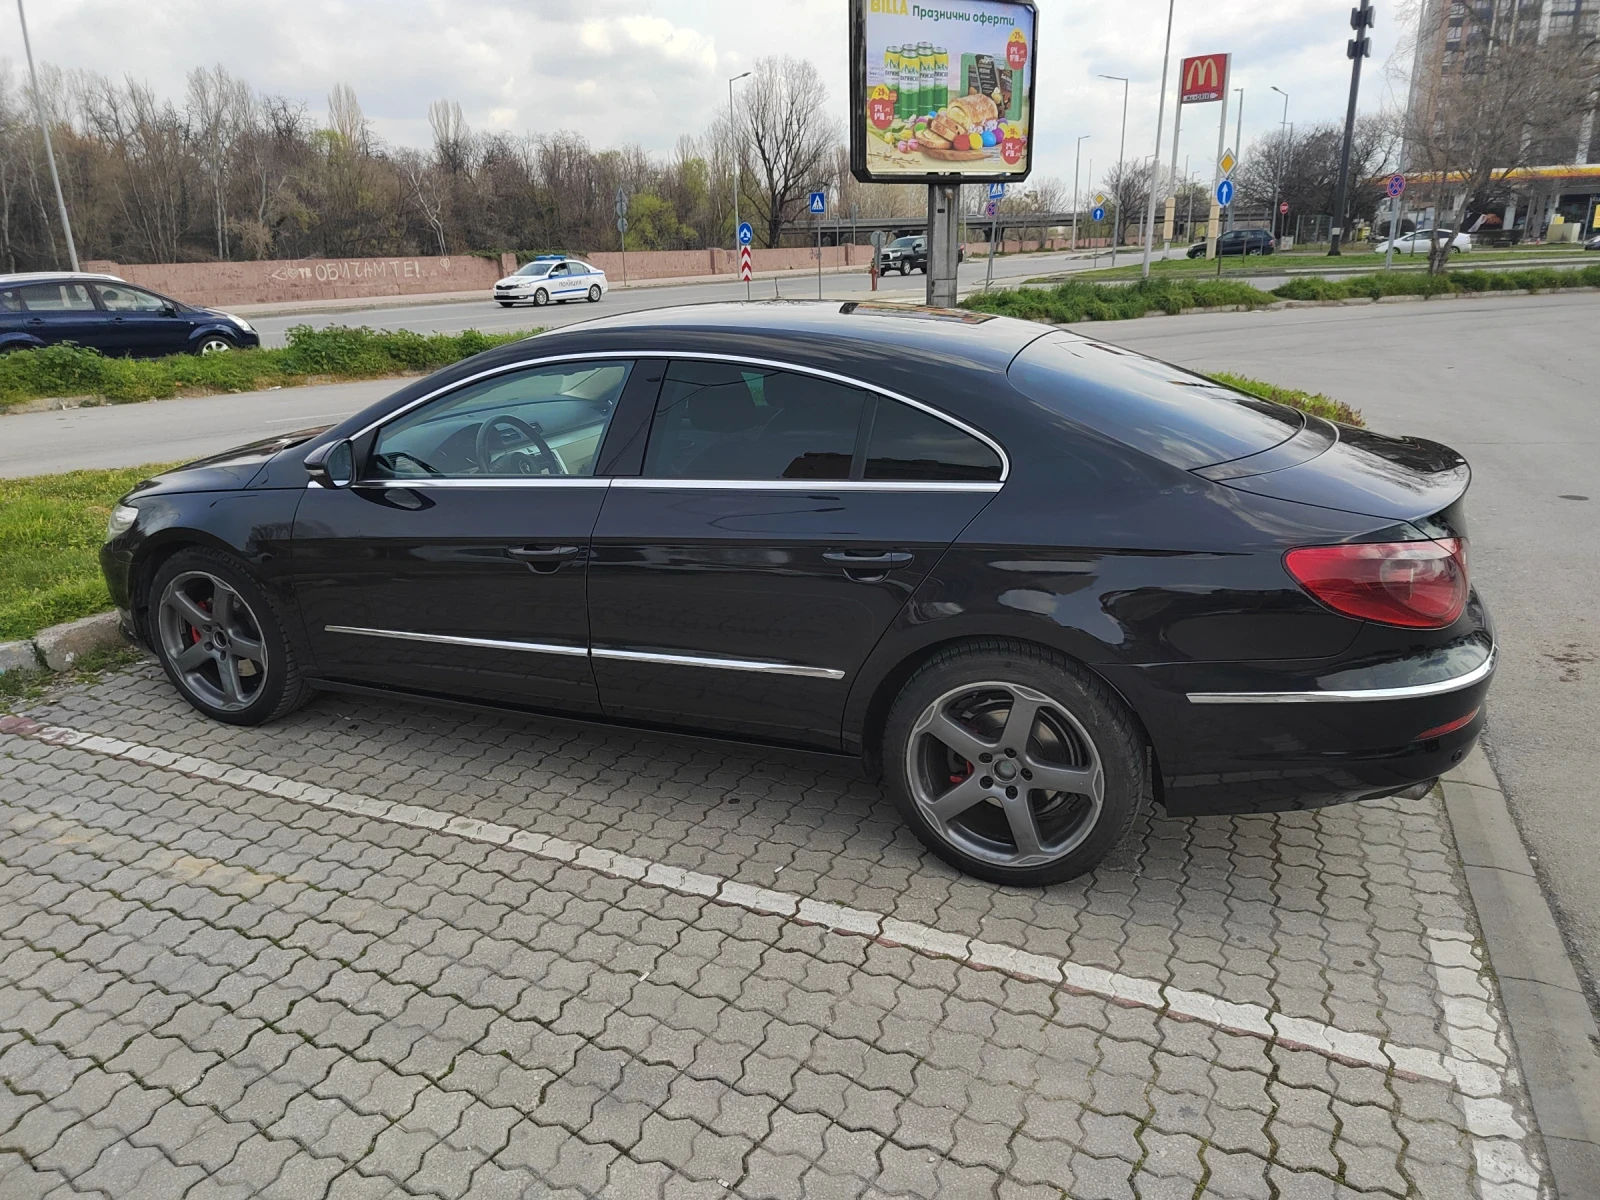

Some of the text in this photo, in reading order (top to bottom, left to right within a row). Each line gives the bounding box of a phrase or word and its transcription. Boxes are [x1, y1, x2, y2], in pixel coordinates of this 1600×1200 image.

[870, 0, 908, 15] BILLA
[912, 5, 1015, 27] Празнични оферти
